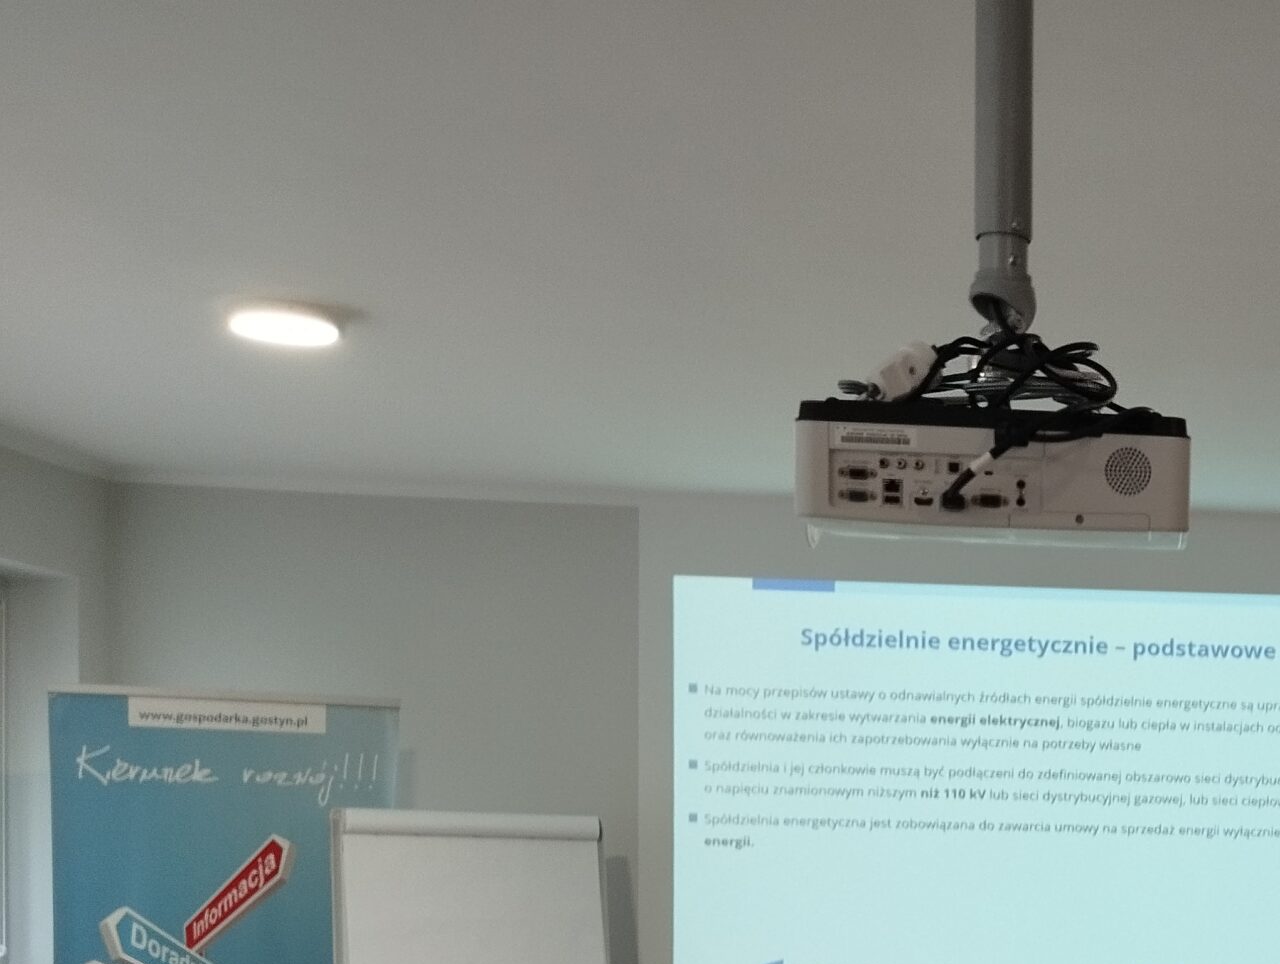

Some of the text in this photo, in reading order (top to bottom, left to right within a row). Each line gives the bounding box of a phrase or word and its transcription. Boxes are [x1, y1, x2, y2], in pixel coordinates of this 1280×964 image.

[800, 626, 941, 651] Spółdzielnie
[947, 635, 1109, 658] energetycznie
[1132, 637, 1277, 661] podstawowe
[703, 683, 722, 696] Na
[725, 686, 760, 700] mocy
[762, 686, 828, 700] przepisów
[830, 688, 876, 704] ustawy
[877, 689, 887, 702] o
[888, 689, 976, 706] odnawialnych
[978, 690, 1032, 706] źródłach
[1033, 693, 1077, 709] energii
[1079, 693, 1153, 709] spółdzielnie
[1155, 698, 1237, 713] energetyczne
[1239, 700, 1254, 715] są
[138, 709, 308, 728] www.gospodarka.gostyn.pl
[703, 706, 777, 720] działalności
[779, 710, 792, 720] w
[794, 708, 846, 722] zakresie
[847, 711, 927, 726] wytwarzania
[929, 711, 976, 729] energii
[978, 712, 1064, 731] elektrycznej,
[1066, 715, 1115, 732] biogazu
[1117, 716, 1138, 732] lub
[1140, 716, 1177, 733] ciepła
[1178, 720, 1191, 732] w
[1192, 719, 1264, 735] instalacjach
[703, 729, 1142, 754] oraz równoważenia ich zapotrzebowania wyłącznie na potrzeby własne
[703, 759, 780, 774] Spółdzielnia
[783, 762, 787, 773] i
[788, 761, 805, 778] jej
[807, 762, 877, 776] członkowie
[879, 765, 921, 781] muszą
[923, 764, 945, 783] być
[947, 765, 1015, 781] podłączeni
[1016, 767, 1034, 780] do
[1036, 767, 1122, 788] zdefiniowanej
[1124, 770, 1192, 786] obszarowo
[1193, 771, 1221, 785] sieci
[703, 784, 712, 794] o
[715, 781, 769, 797] napięciu
[772, 784, 864, 800] znamionowym
[866, 785, 917, 802] niższym
[919, 785, 940, 800] niż
[943, 786, 966, 800] 110
[968, 786, 987, 802] kV
[988, 787, 1009, 801] lub
[1012, 788, 1039, 802] sieci
[1041, 789, 1131, 807] dystrybucyjnej
[1133, 792, 1186, 808] gazowej,
[1188, 792, 1209, 806] lub
[1211, 793, 1238, 806] sieci
[703, 812, 780, 827] Spółdzielnia
[782, 816, 867, 831] energetyczna
[868, 815, 892, 832] jest
[894, 817, 976, 832] zobowiązana
[977, 817, 995, 832] do
[997, 820, 1051, 833] zawarcia
[1053, 822, 1100, 837] umowy
[1101, 823, 1118, 835] na
[1120, 822, 1176, 837] sprzedaż
[1177, 824, 1220, 839] energii
[1222, 824, 1280, 840] wyłącznie
[702, 834, 757, 850] energii.
[193, 851, 277, 940] Informacja
